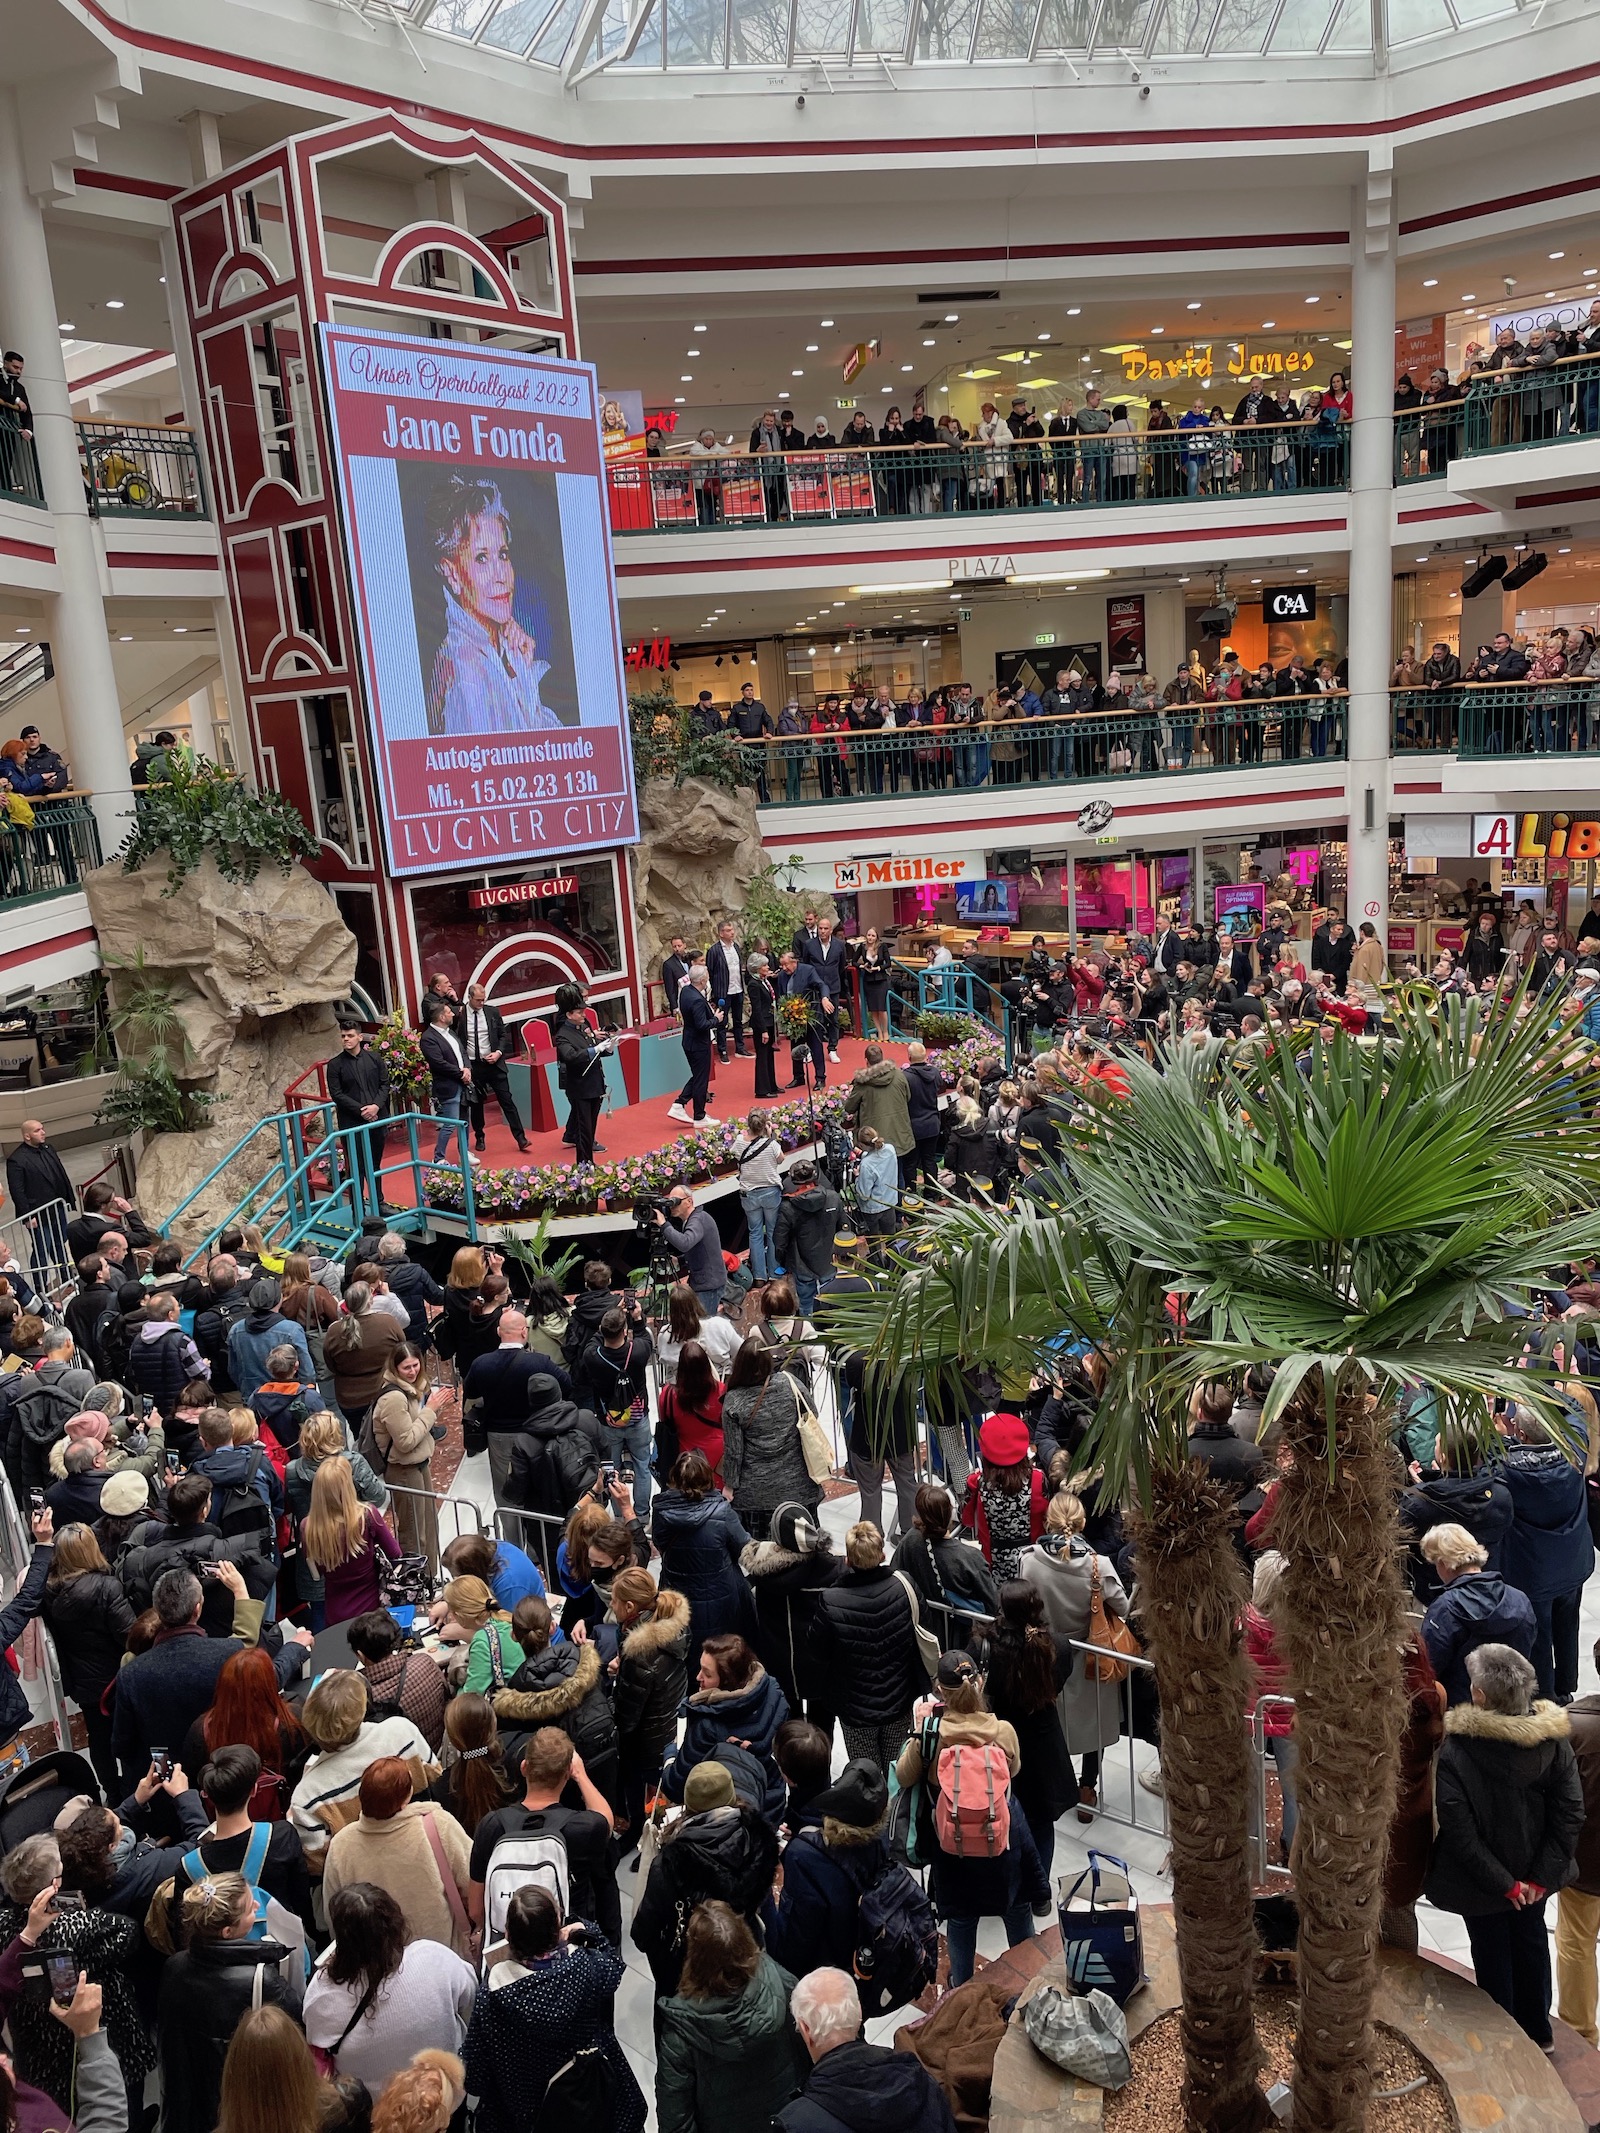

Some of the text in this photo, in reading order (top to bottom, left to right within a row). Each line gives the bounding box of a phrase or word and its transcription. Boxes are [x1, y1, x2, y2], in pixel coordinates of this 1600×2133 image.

[1121, 343, 1315, 381] David Jones
[1395, 351, 1441, 369] schließen!
[1410, 340, 1427, 350] Wir
[349, 346, 580, 407] Unser Opernballgast 2023
[382, 404, 566, 463] Jane Fonda
[948, 556, 1016, 578] PLAZA
[1273, 593, 1309, 615] C&A
[624, 635, 671, 673] H&M
[425, 736, 594, 772] Autogrammstunde
[427, 769, 598, 809] Mi., 15.02.23 13h
[403, 800, 625, 857] LUGNER CITY
[841, 858, 966, 884] M Müller
[1289, 850, 1320, 885] T
[479, 878, 573, 907] LUGNER CITY
[915, 883, 941, 911] T
